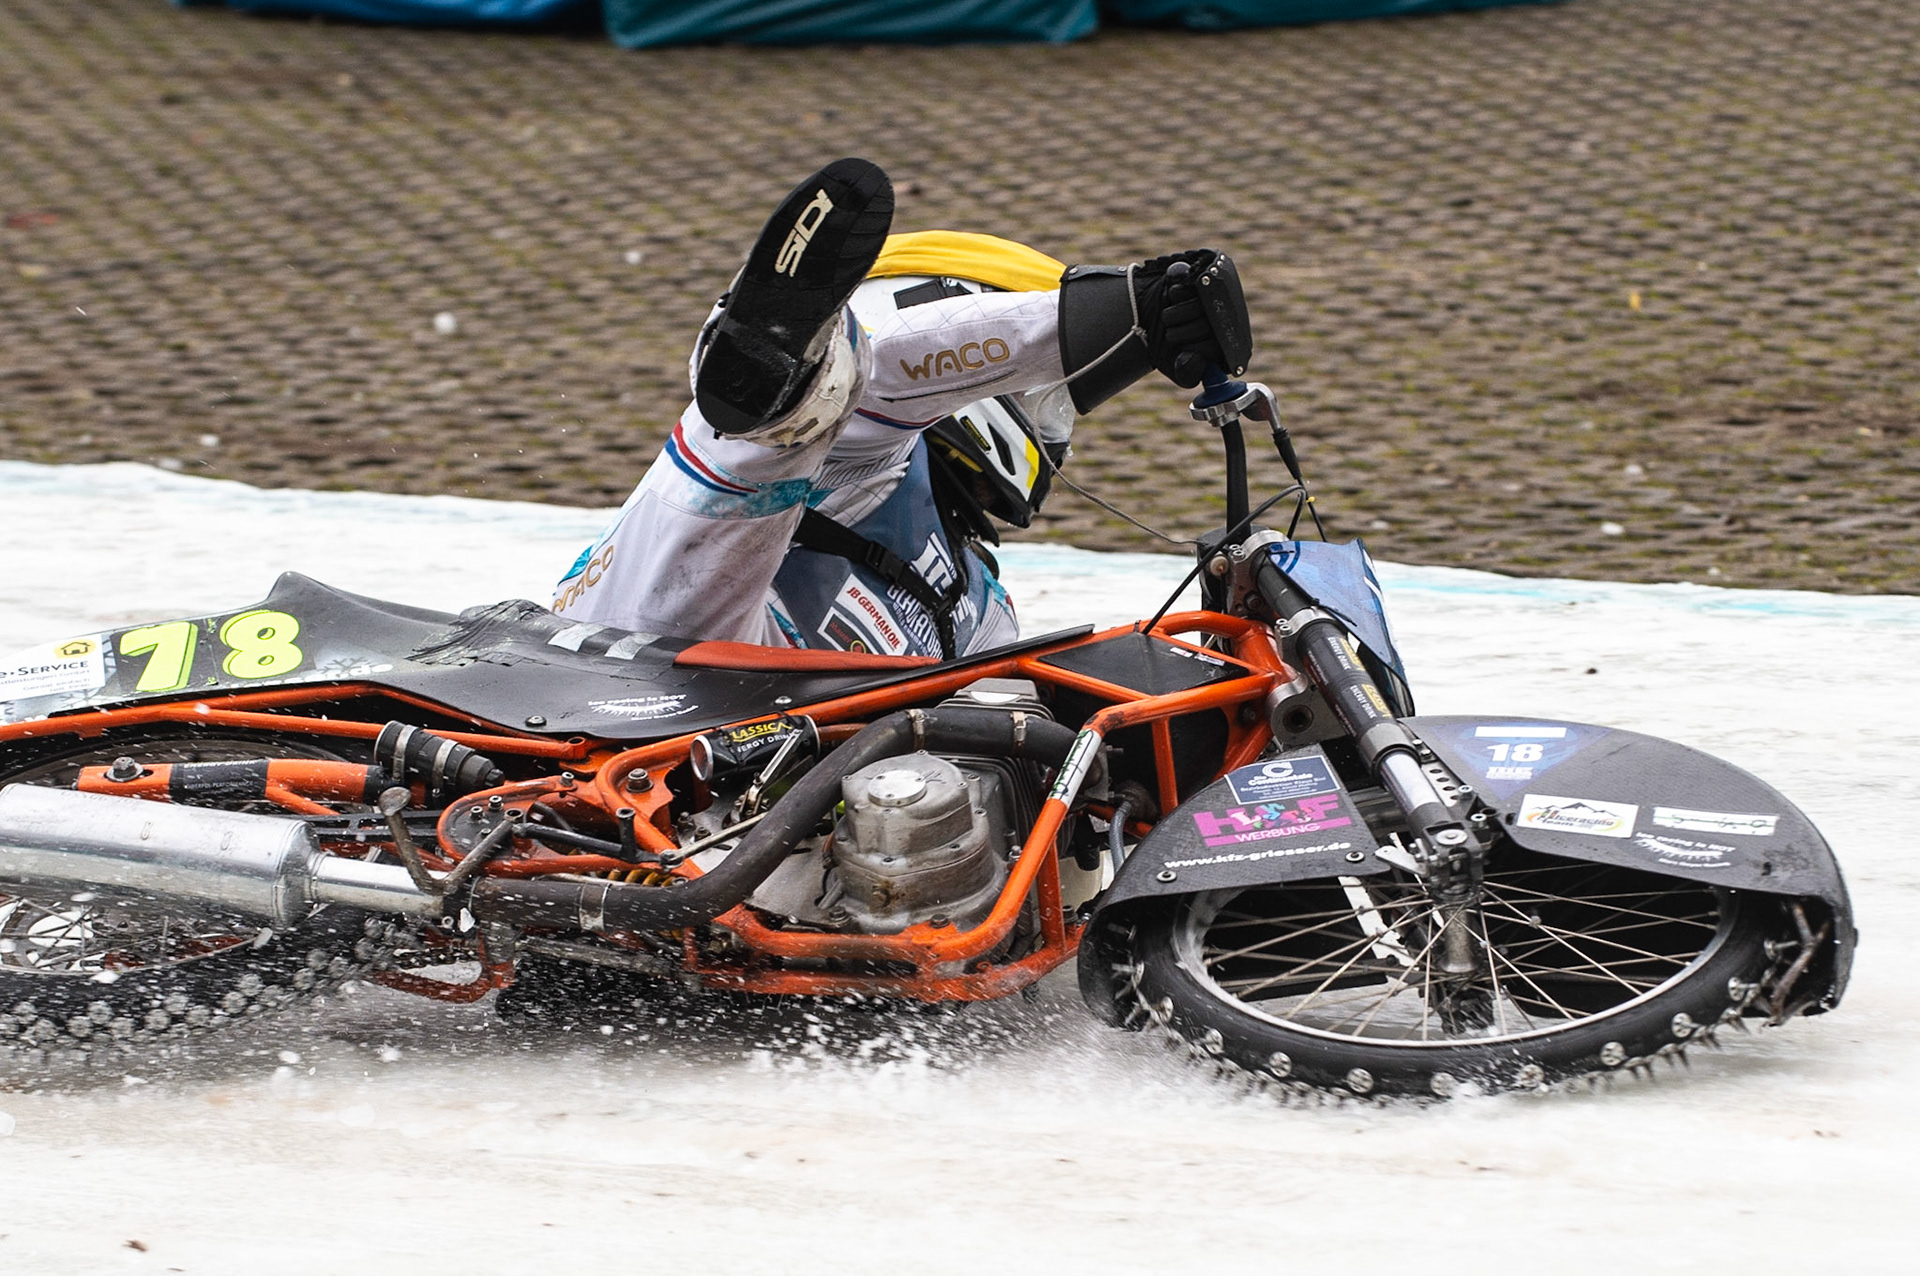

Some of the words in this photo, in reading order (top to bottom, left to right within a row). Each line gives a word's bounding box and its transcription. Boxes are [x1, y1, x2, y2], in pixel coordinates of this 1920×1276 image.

[775, 188, 834, 277] SIDI
[900, 338, 1010, 381] WACO
[846, 587, 861, 602] JB
[1487, 743, 1544, 762] 18
[1234, 823, 1321, 842] WERBUNG
